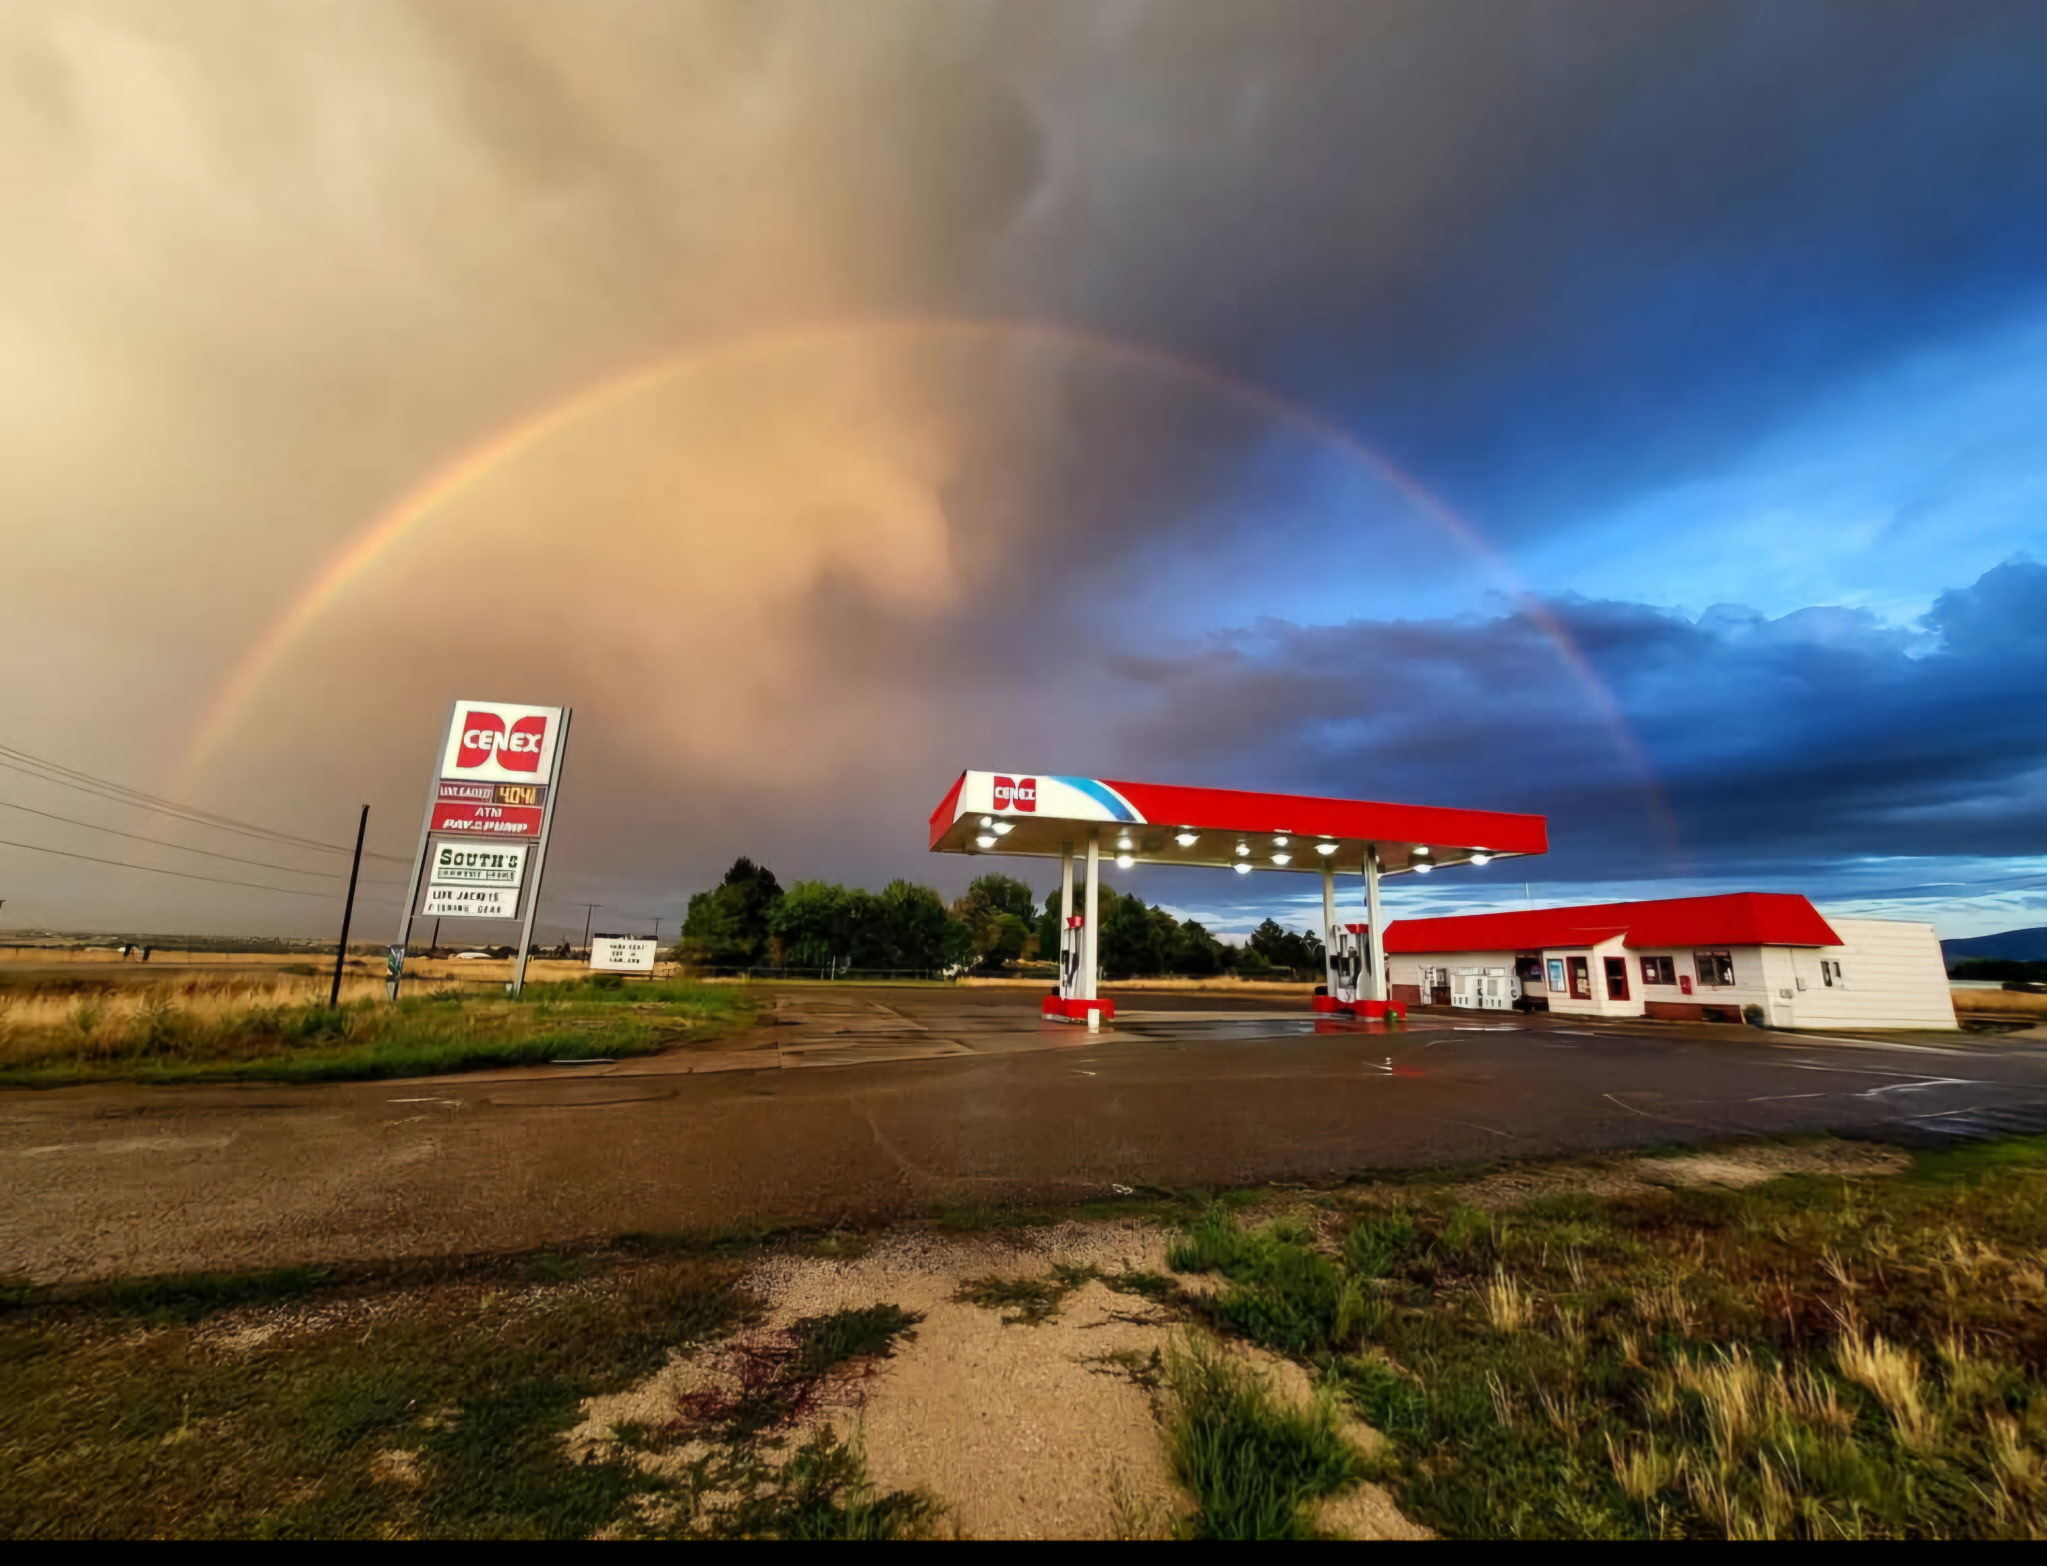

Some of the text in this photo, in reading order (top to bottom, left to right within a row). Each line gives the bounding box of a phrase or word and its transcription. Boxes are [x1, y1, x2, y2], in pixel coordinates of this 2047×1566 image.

[463, 730, 541, 753] CENEX
[994, 786, 1036, 800] CENEX
[474, 807, 503, 817] ATM
[483, 821, 528, 833] PUMP
[440, 849, 518, 868] SOUTH'S
